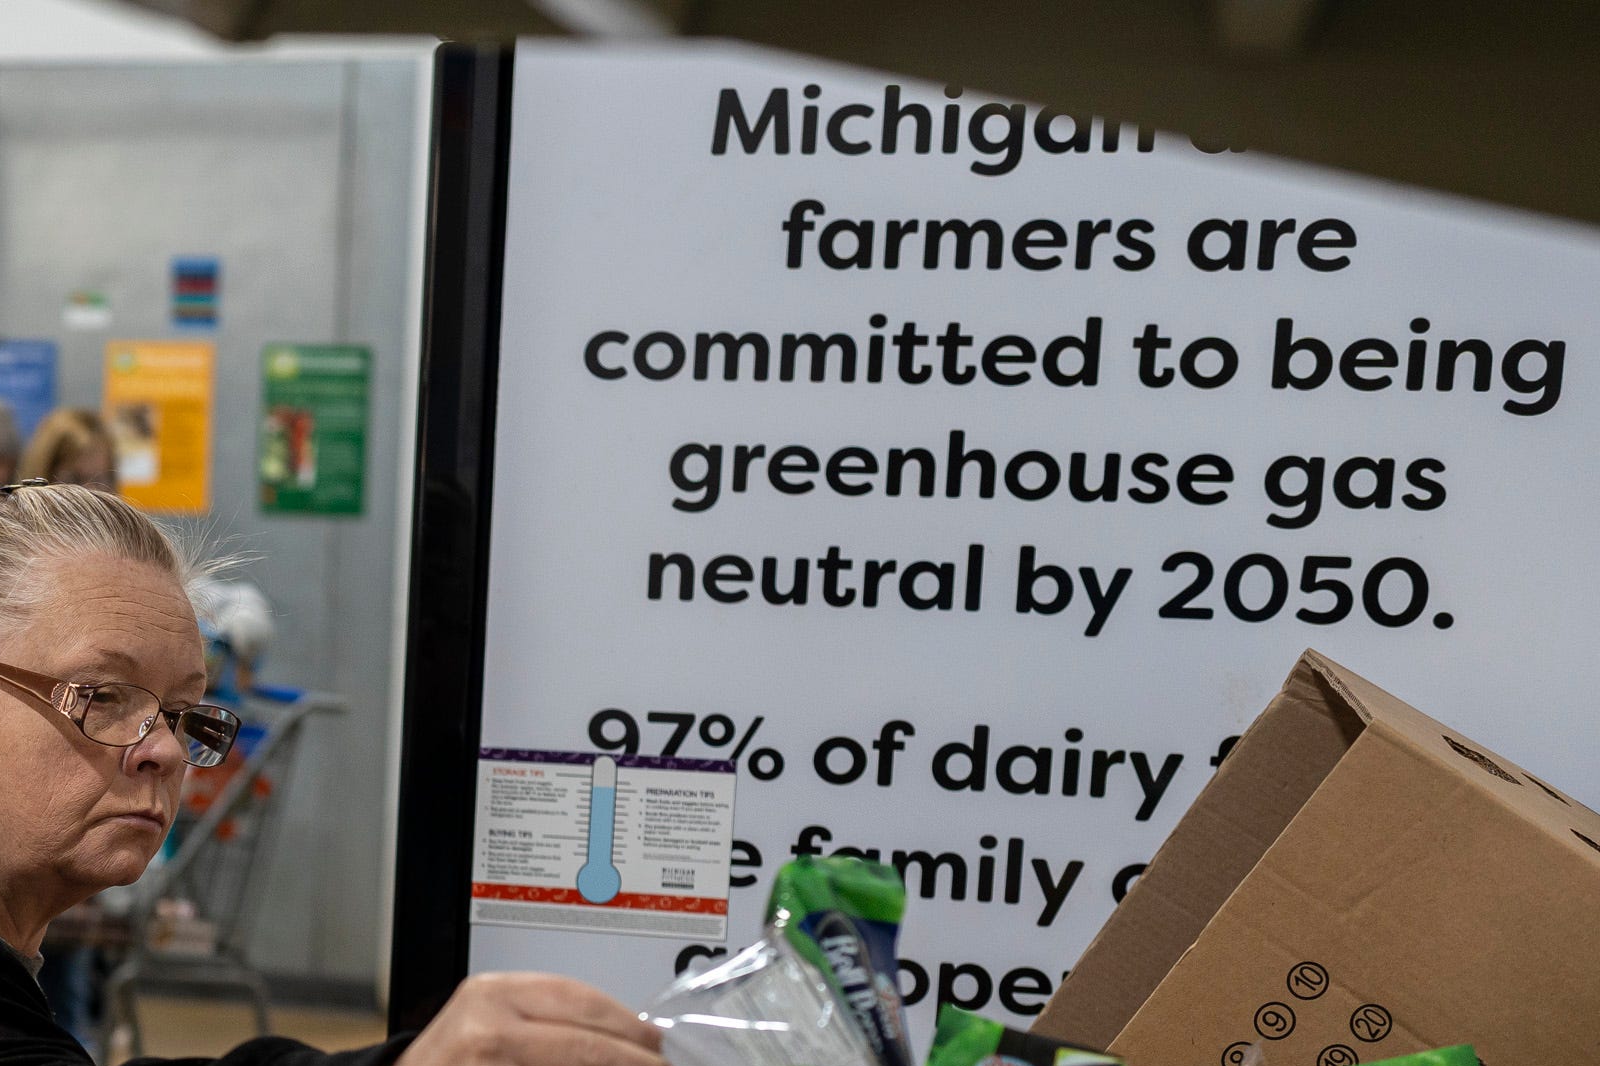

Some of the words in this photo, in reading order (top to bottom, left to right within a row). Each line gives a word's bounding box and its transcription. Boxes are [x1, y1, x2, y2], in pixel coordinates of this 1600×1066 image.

[784, 199, 1156, 272] farmers
[1188, 218, 1357, 272] are
[584, 316, 1103, 389] committed
[1132, 323, 1239, 390] to
[1271, 317, 1566, 417] being
[669, 429, 1235, 514] greenhouse
[1264, 455, 1448, 530] gas
[647, 543, 986, 613] neutral
[1015, 545, 1134, 639] by
[1158, 551, 1455, 630] 2050.
[587, 708, 786, 782] 97%
[812, 719, 917, 788] of
[931, 724, 1185, 823] dairy
[645, 787, 698, 798] PREPARATION
[700, 790, 716, 799] TIPS
[791, 825, 1085, 927] fmily
[1294, 965, 1324, 992] 10
[1355, 1008, 1387, 1039] 20
